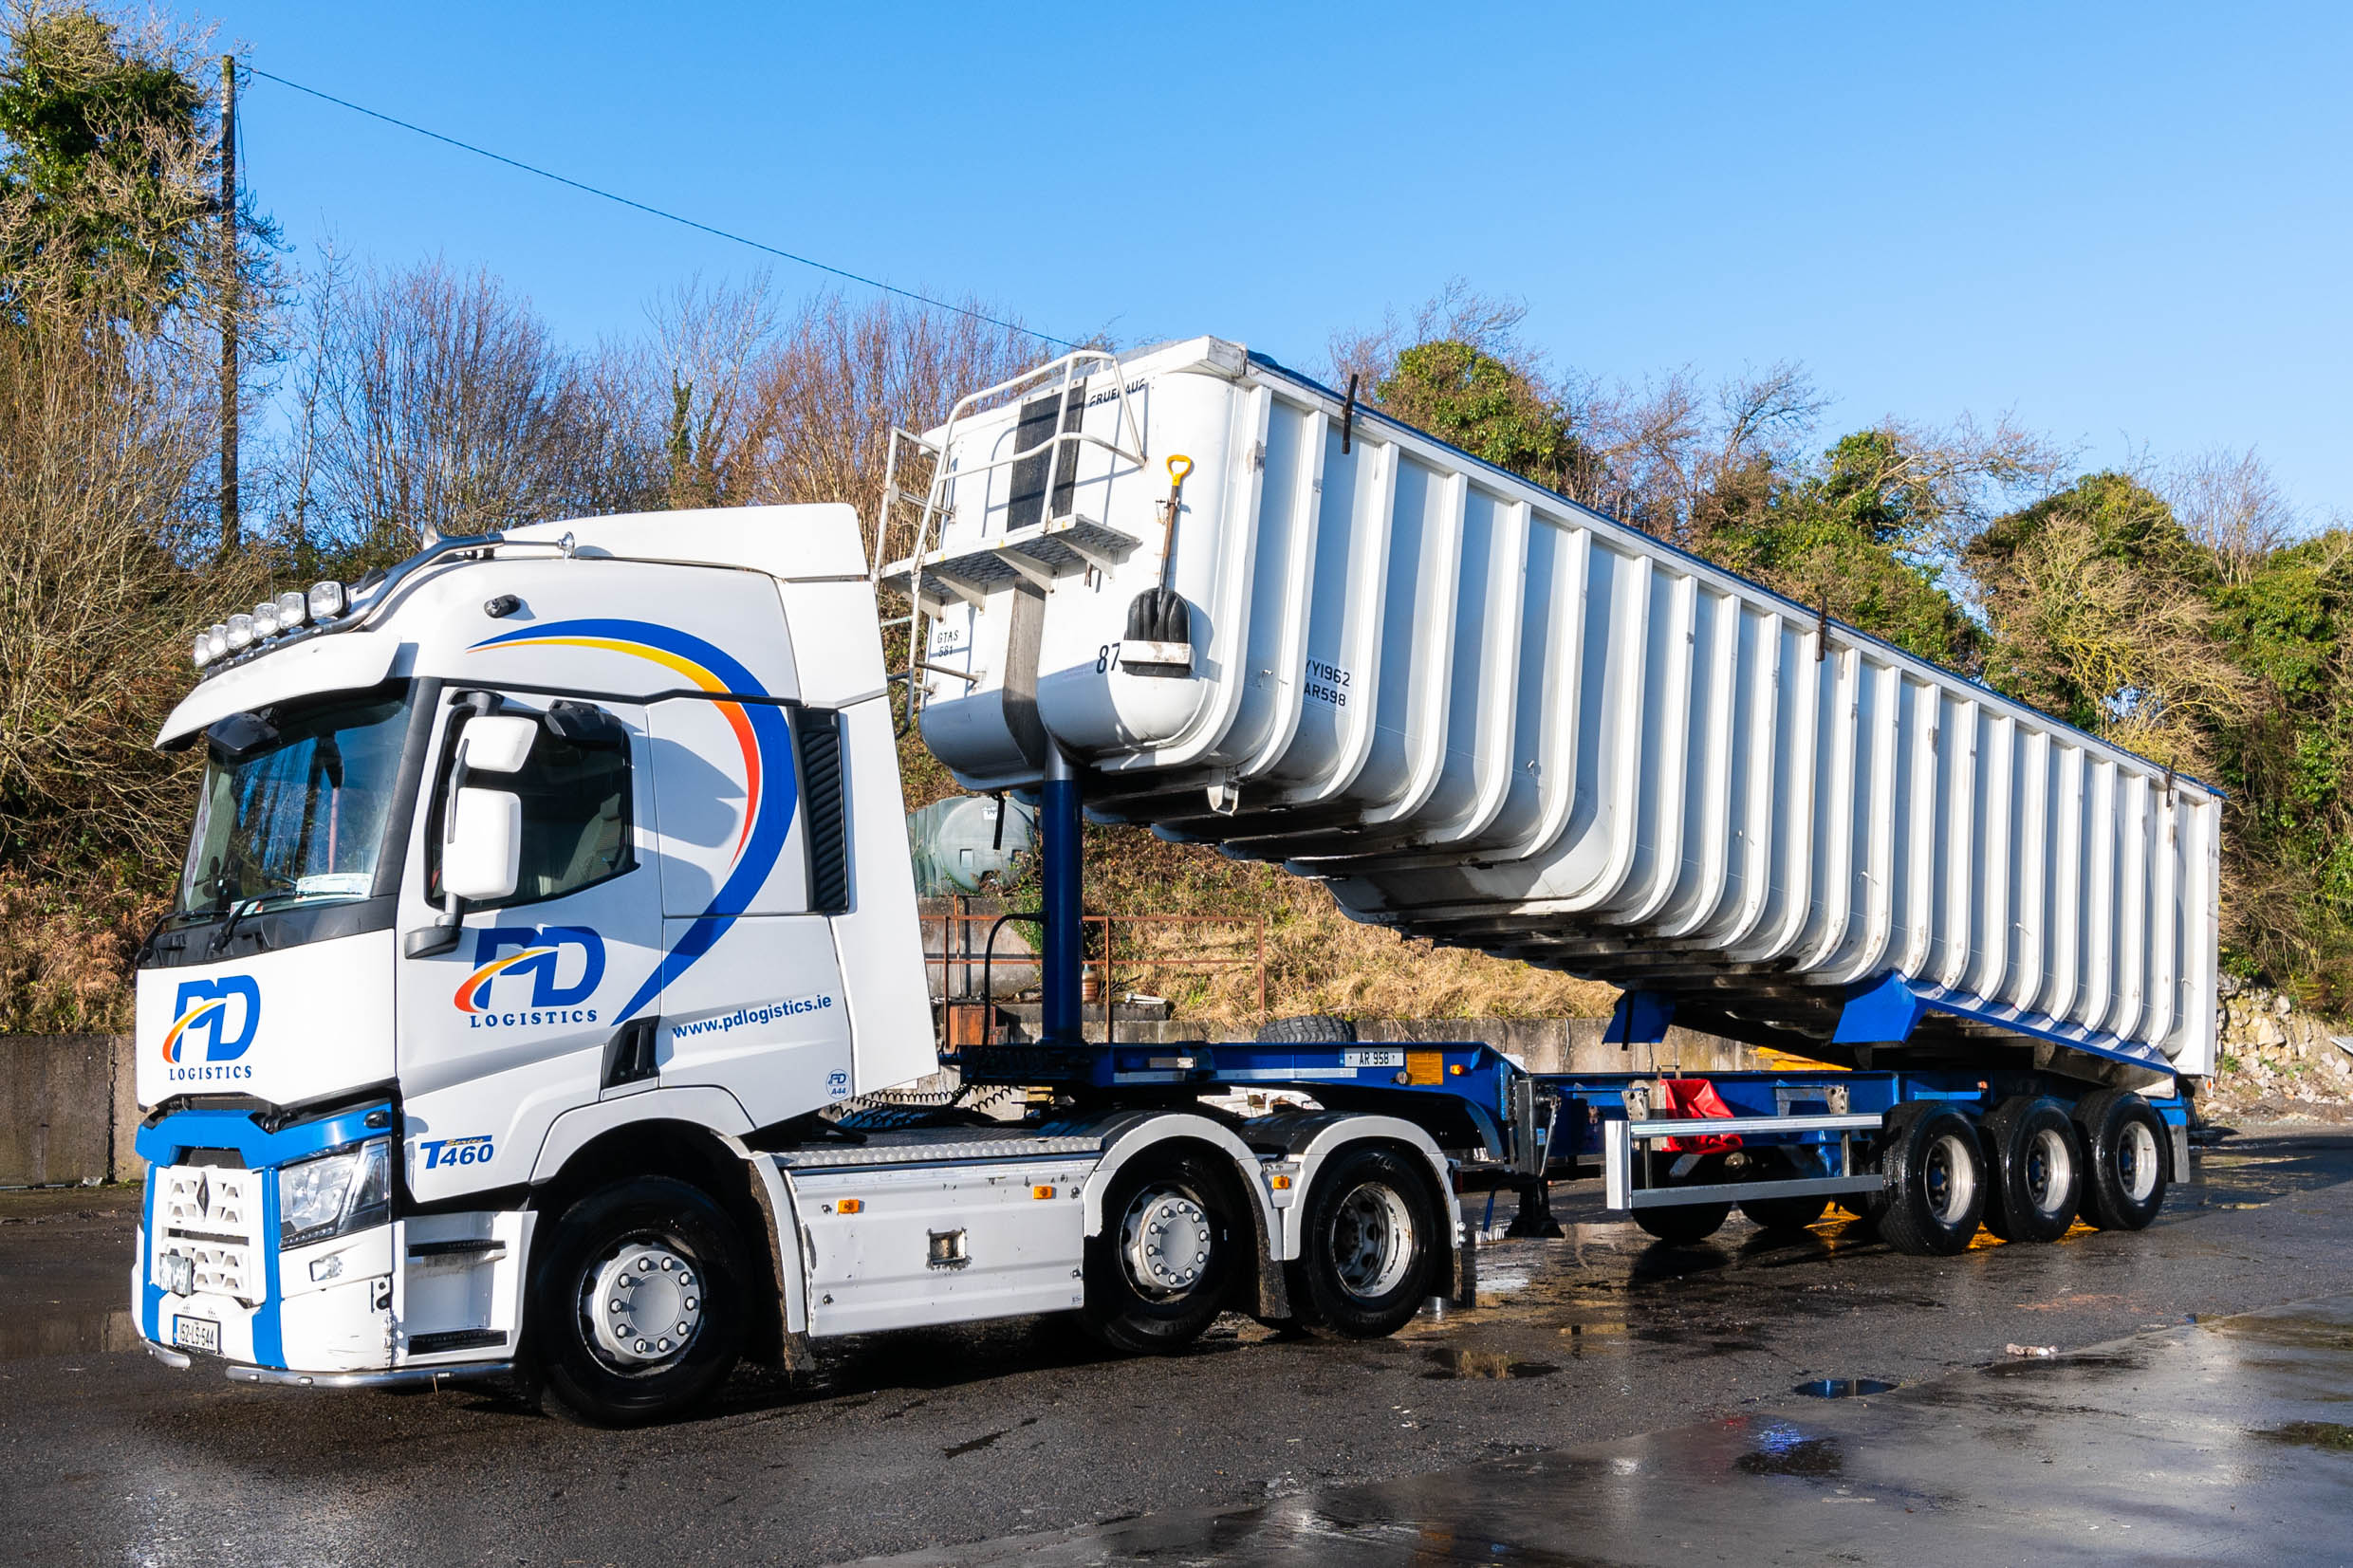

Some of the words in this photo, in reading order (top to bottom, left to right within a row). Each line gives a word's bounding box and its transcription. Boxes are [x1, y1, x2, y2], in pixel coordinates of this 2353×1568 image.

[1088, 378, 1146, 407] FRUEAUF
[1096, 642, 1121, 674] 87
[1305, 682, 1346, 707] AR598
[473, 926, 606, 1010] PD
[174, 974, 261, 1063] PD
[470, 1009, 598, 1028] LOGISTICS
[672, 994, 832, 1039] www.pdlogistics.ie
[170, 1065, 252, 1080] LOGISTICS
[1360, 1051, 1370, 1065] AR
[420, 1134, 494, 1170] T460
